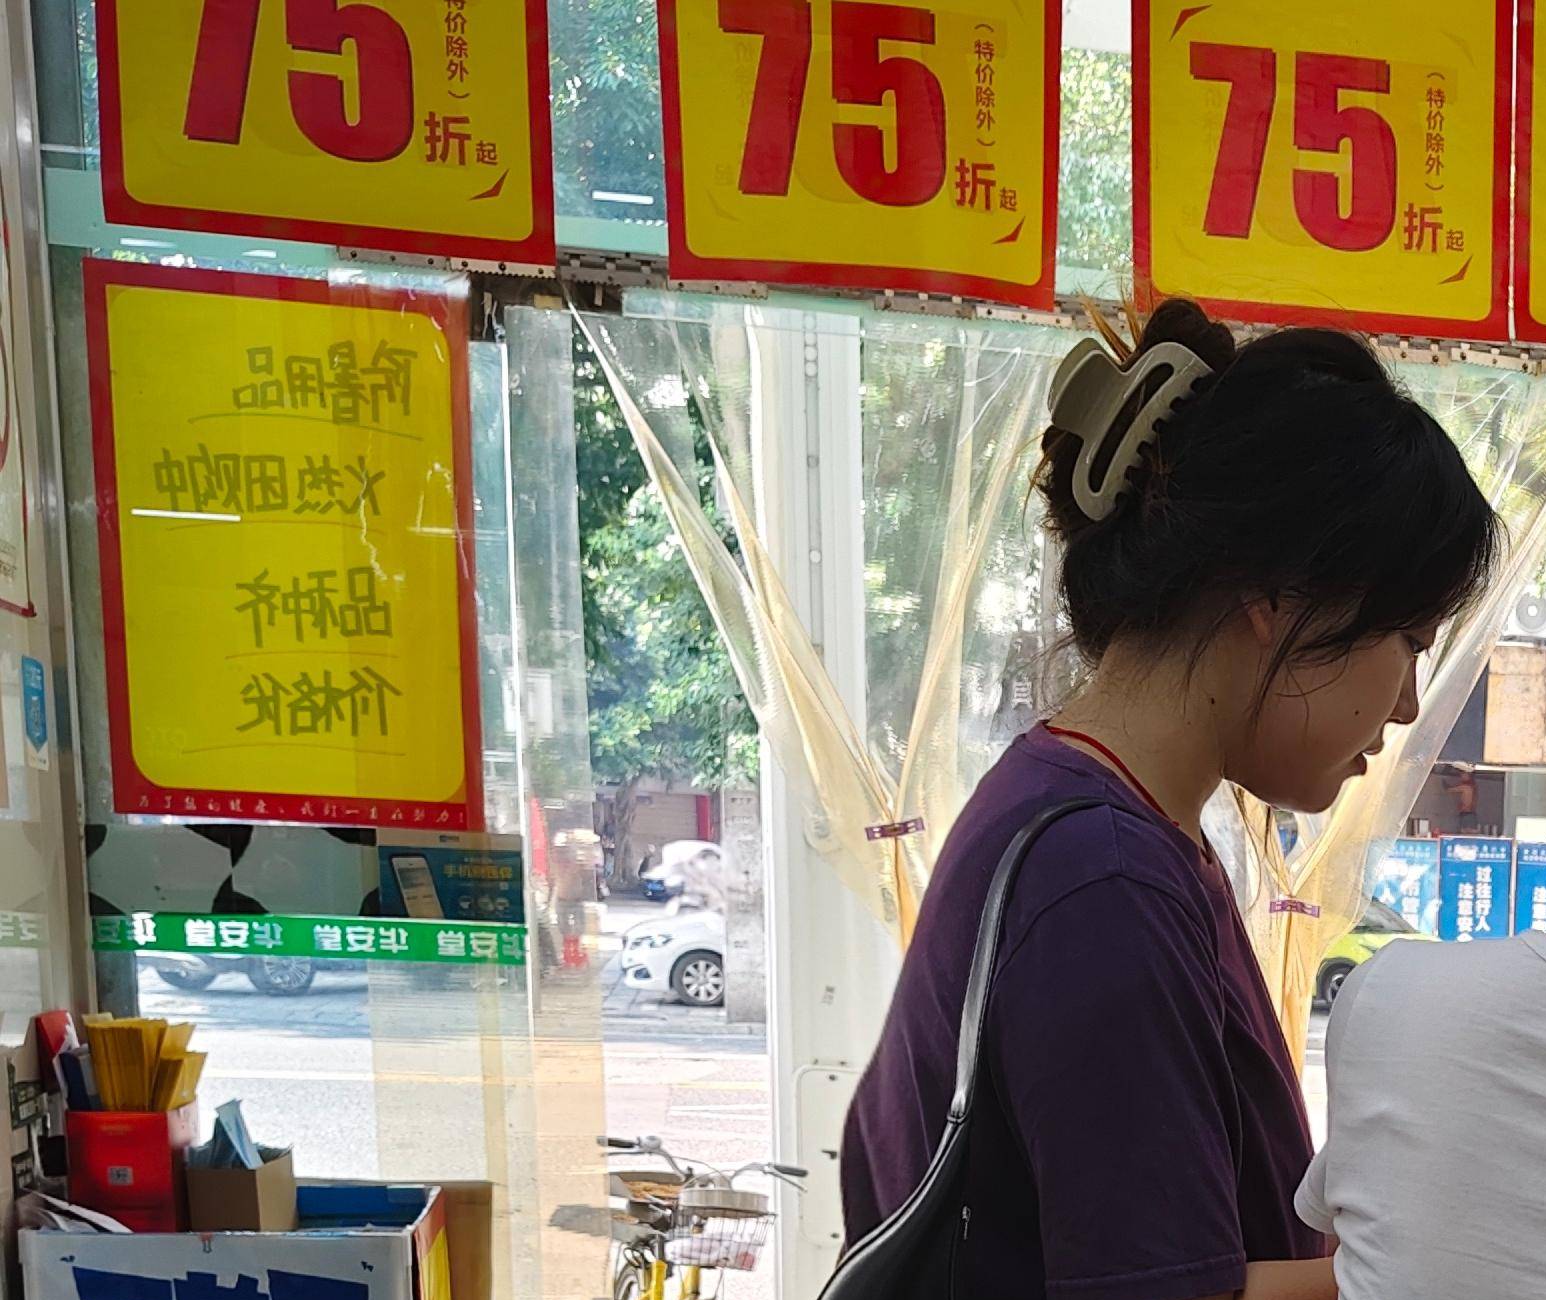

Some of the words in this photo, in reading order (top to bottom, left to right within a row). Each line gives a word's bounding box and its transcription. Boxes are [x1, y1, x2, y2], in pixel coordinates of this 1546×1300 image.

[184, 0, 415, 163] 75
[718, 0, 946, 207] 75
[1189, 41, 1397, 253] 75
